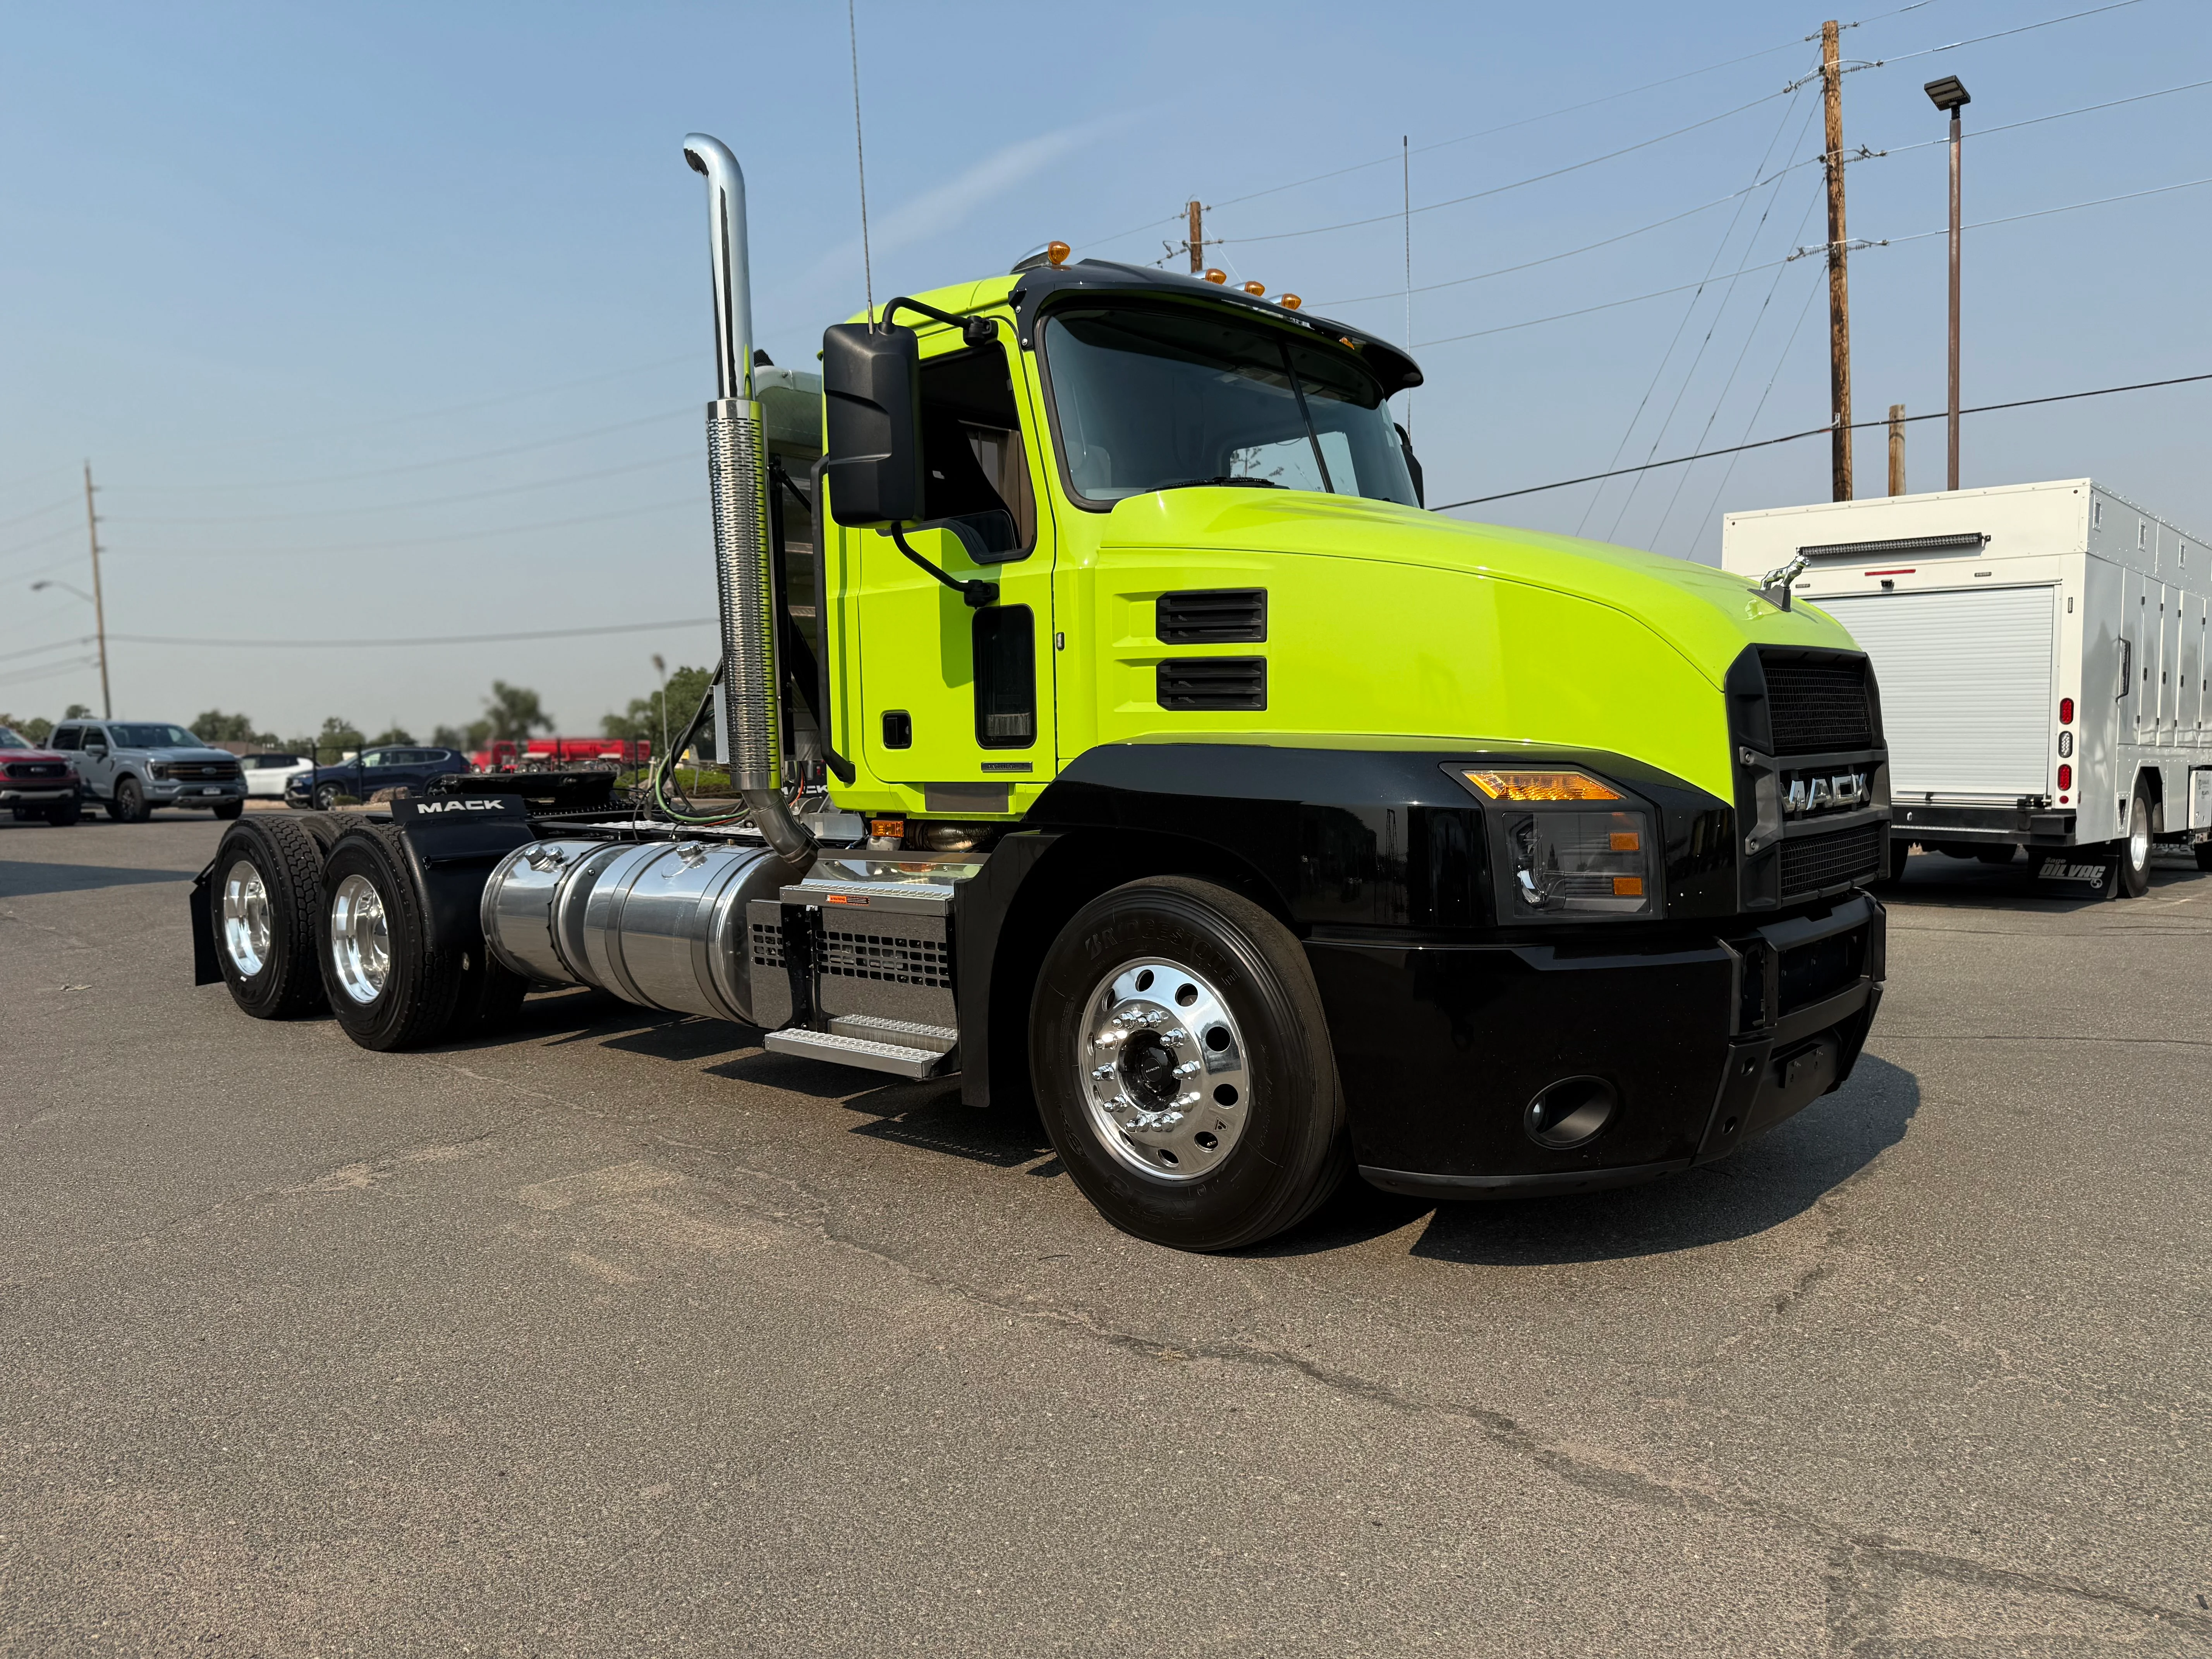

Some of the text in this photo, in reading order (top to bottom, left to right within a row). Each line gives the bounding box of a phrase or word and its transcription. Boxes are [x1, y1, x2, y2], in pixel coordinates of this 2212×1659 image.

[1780, 773, 1871, 813] MACK
[417, 800, 505, 814] MACK
[2039, 864, 2106, 878] OIL VAC
[1084, 919, 1241, 986] BRIDGESTONE
